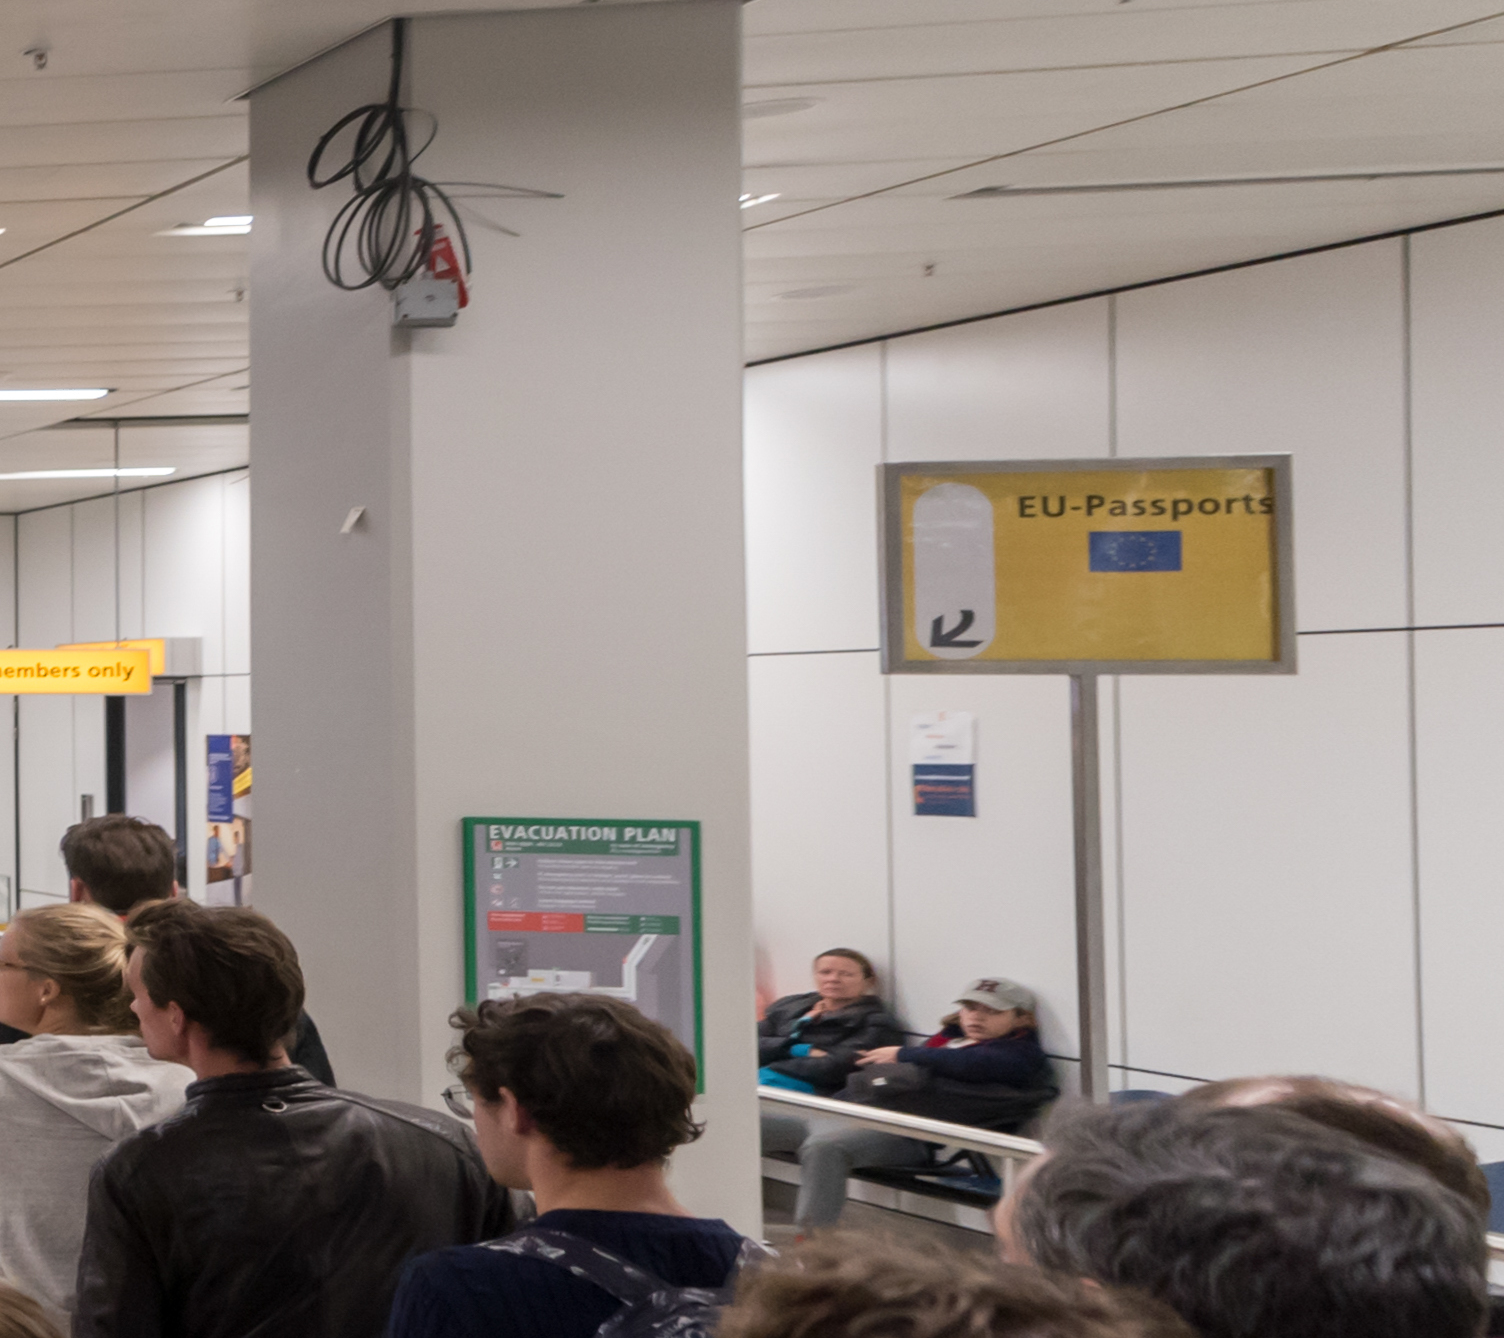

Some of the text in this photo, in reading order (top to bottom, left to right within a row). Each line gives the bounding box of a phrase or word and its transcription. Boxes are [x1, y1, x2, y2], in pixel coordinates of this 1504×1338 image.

[1018, 494, 1273, 521] EU-Passports
[88, 661, 135, 682] only
[489, 824, 677, 842] EVACUATION PLAN
